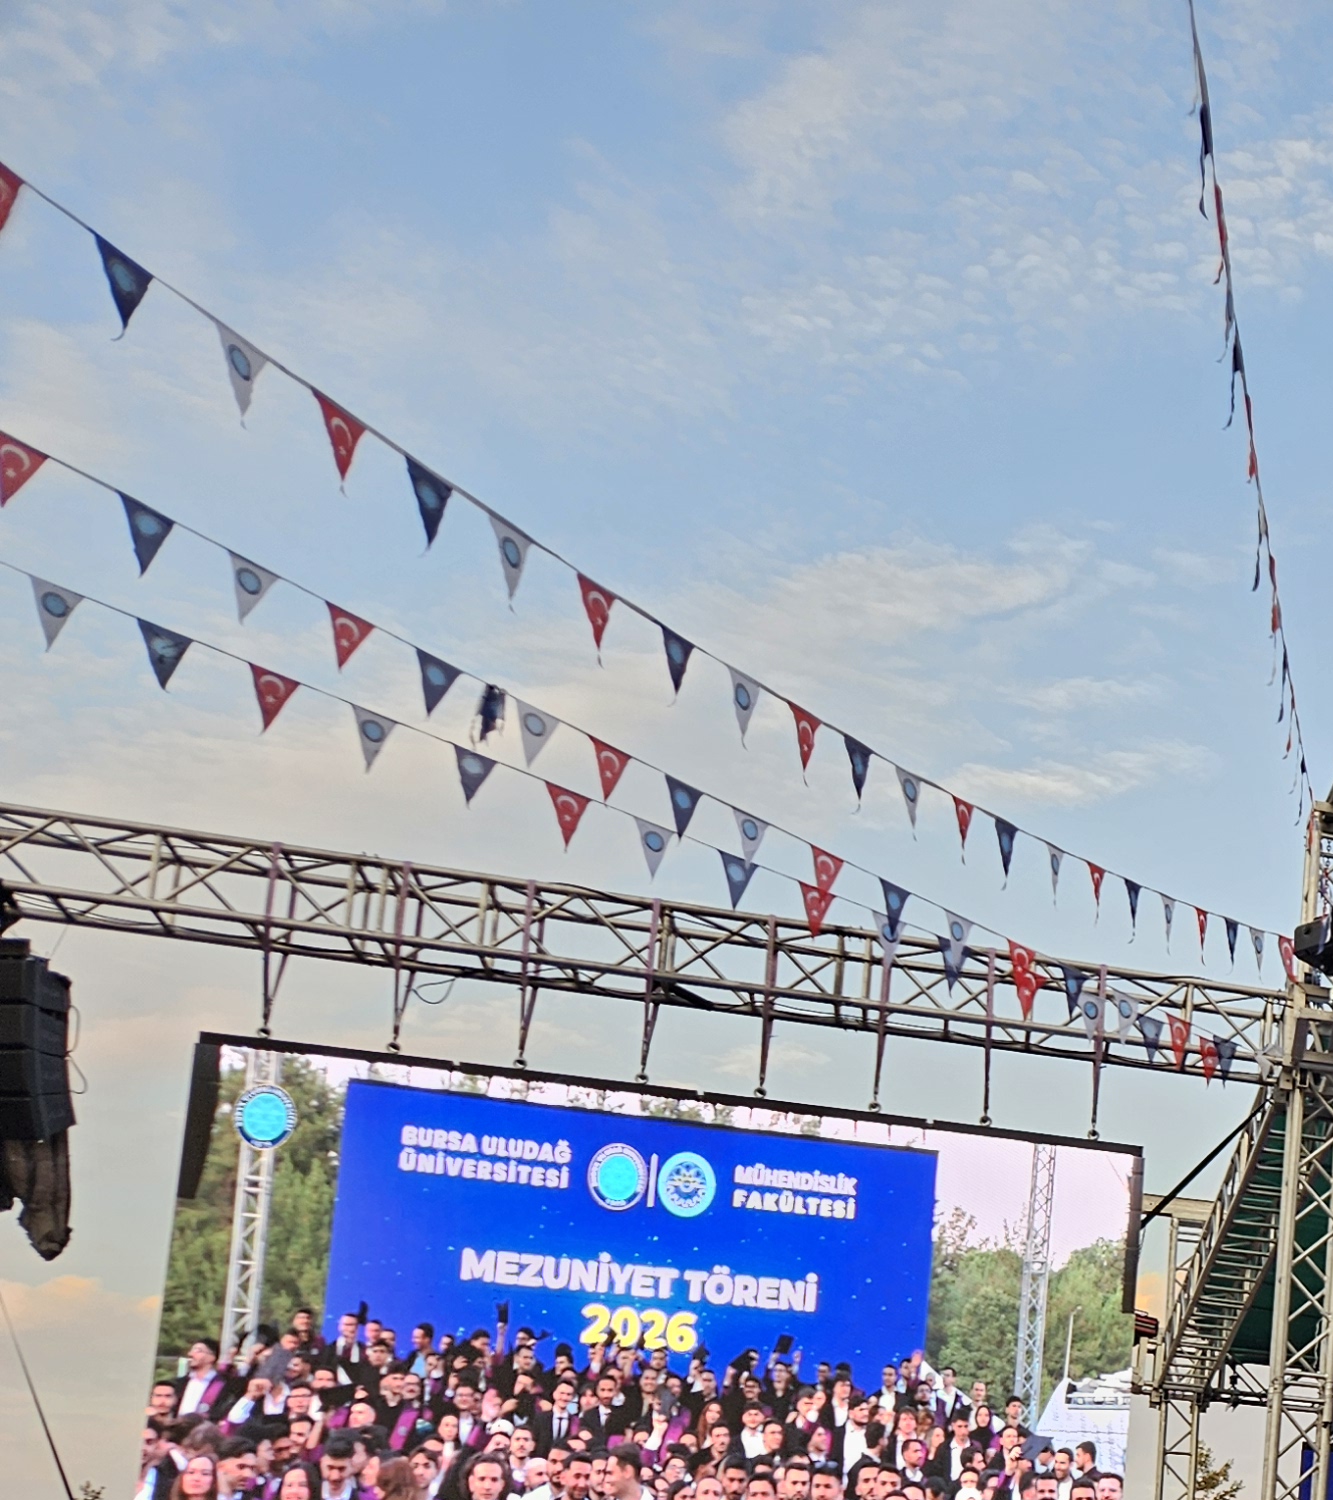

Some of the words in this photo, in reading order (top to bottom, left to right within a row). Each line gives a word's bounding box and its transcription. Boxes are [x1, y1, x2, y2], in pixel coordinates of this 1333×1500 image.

[401, 1125, 478, 1154] BURSA
[481, 1135, 573, 1164] ULUDAĞ
[398, 1147, 570, 1189] ÜNİVERSİTESİ
[733, 1162, 858, 1196] MÜHENDİSLİK
[732, 1189, 856, 1220] FAKÜLTESİ
[460, 1247, 680, 1299] MEZUNİYET
[684, 1265, 818, 1313] TÖRENİ
[580, 1302, 698, 1353] 2026
